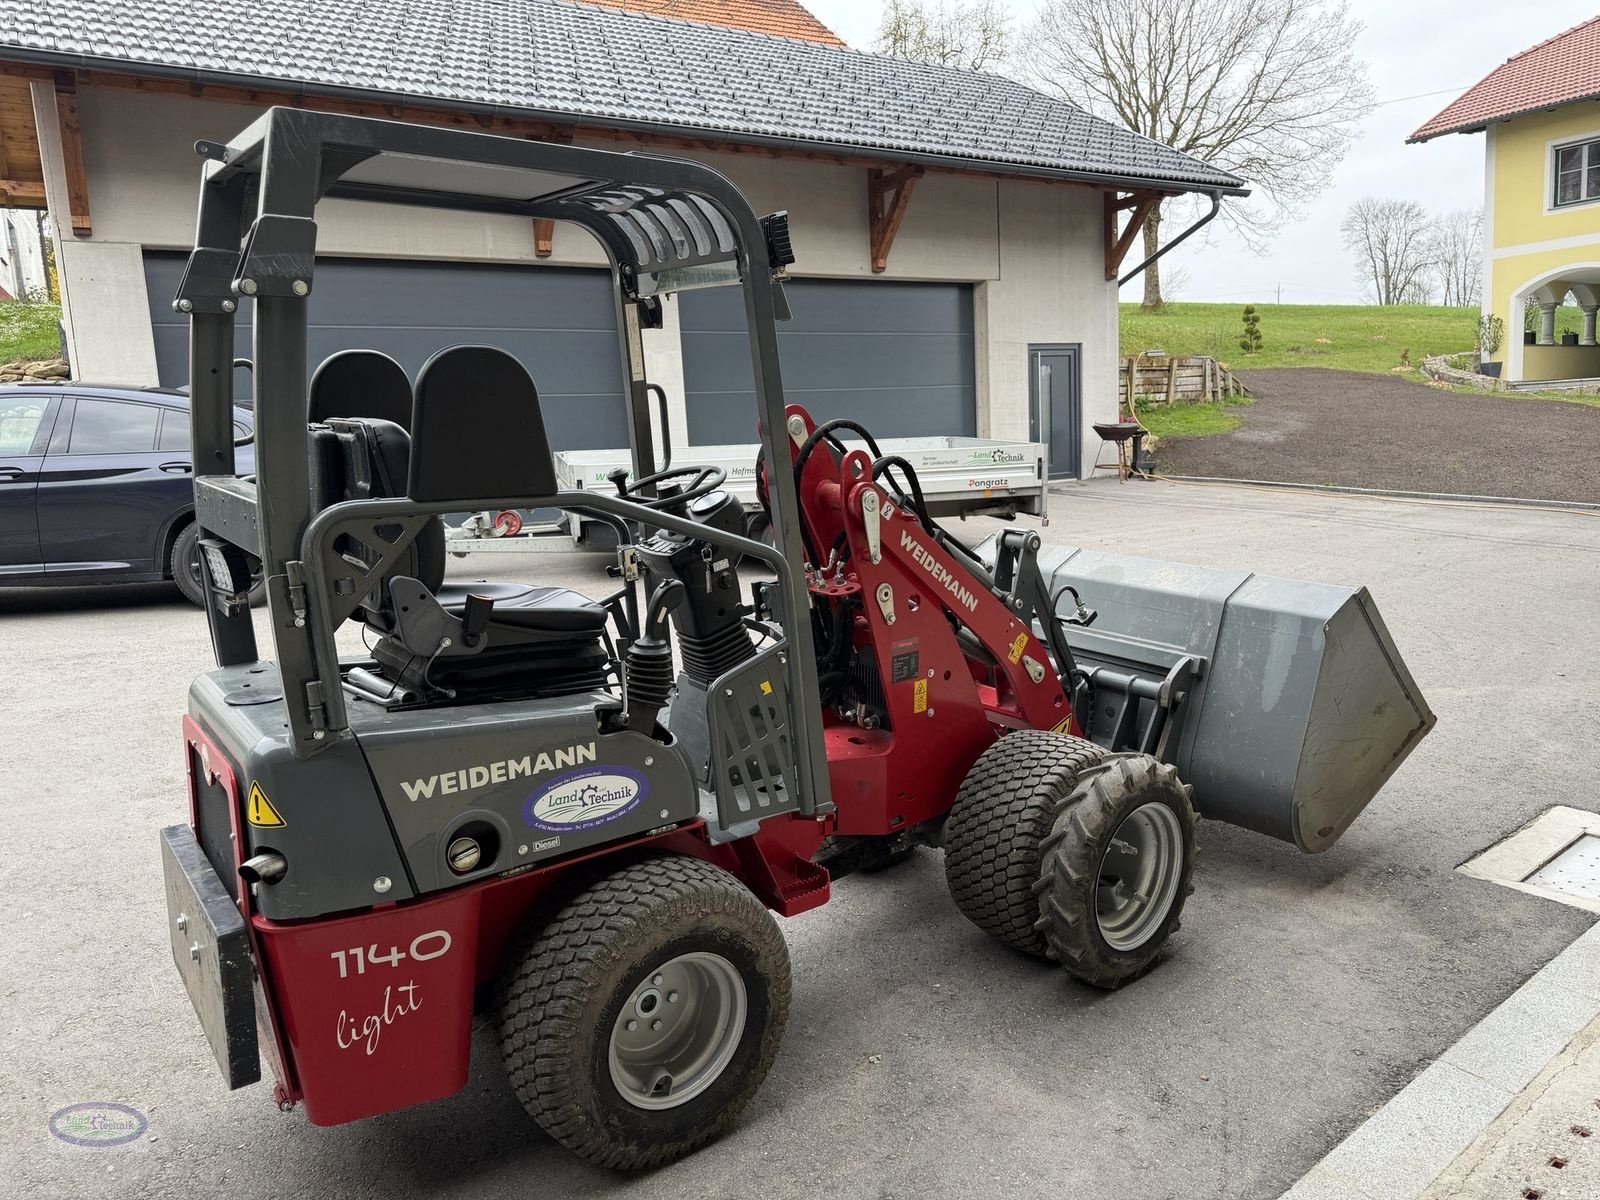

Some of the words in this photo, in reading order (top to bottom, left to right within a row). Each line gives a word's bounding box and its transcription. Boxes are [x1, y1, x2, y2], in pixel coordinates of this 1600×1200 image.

[973, 450, 992, 459] Land
[997, 453, 1025, 463] Technik
[732, 466, 756, 476] Hofma
[968, 478, 1009, 489] Pongratz
[899, 529, 979, 613] WEIDEMANN
[399, 742, 597, 802] WEIDEMANN
[547, 789, 578, 808] Land
[588, 785, 632, 806] Technik
[534, 836, 559, 851] Diesel
[331, 930, 452, 978] 1140
[336, 979, 423, 1056] light
